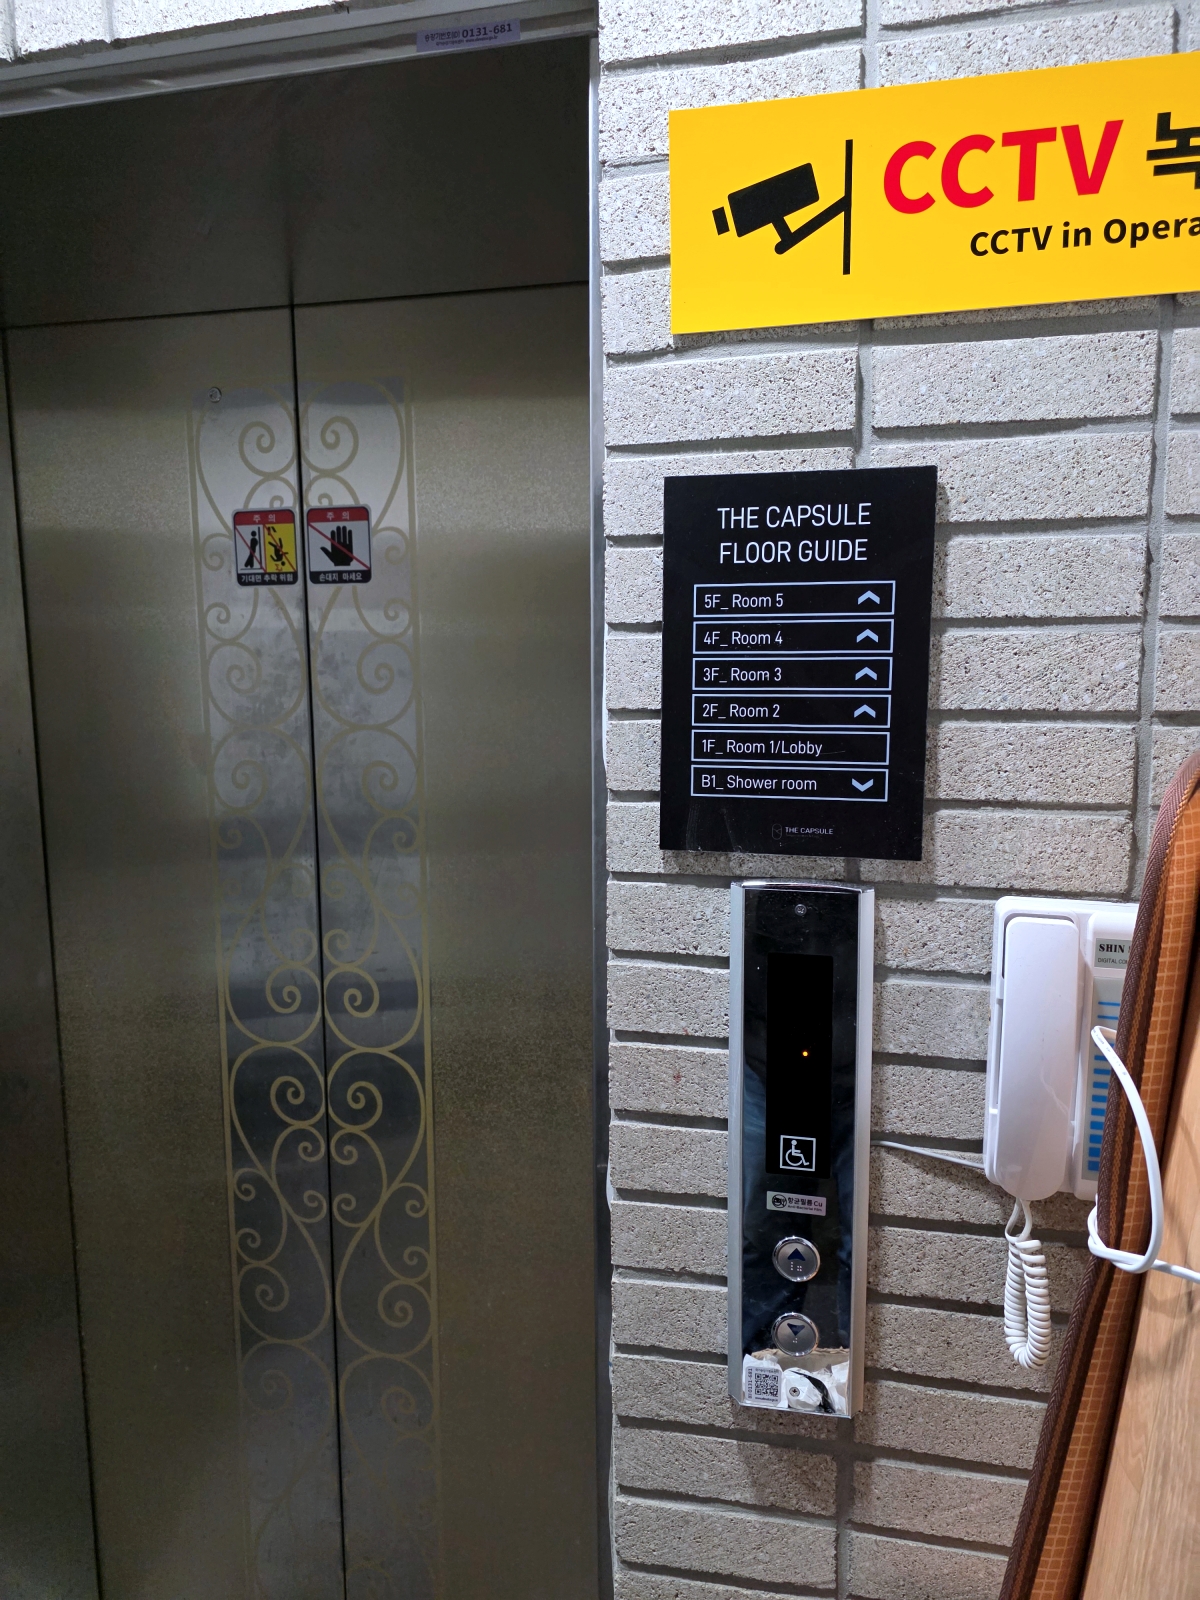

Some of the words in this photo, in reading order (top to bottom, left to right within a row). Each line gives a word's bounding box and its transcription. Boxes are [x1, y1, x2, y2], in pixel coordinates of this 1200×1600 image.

[461, 23, 513, 39] 0131-681
[883, 119, 1124, 215] CCTV
[1145, 111, 1200, 190] 녹
[969, 225, 1053, 258] CCTV
[1062, 221, 1093, 249] in
[1103, 216, 1200, 250] Opera
[717, 506, 760, 530] THE
[765, 502, 872, 528] CAPSULE
[719, 540, 792, 564] FLOOR
[798, 538, 868, 562] GUIDE
[318, 572, 339, 583] 손대지
[342, 571, 363, 581] 마세요
[704, 594, 729, 610] 5F_
[732, 593, 772, 608] Room
[775, 593, 784, 607] 5
[703, 631, 729, 647] 4F_
[731, 631, 771, 645] Room
[774, 630, 783, 645] 4
[703, 668, 727, 683] 3F_
[730, 667, 770, 681] Room
[774, 667, 782, 681] 3
[702, 703, 726, 719] 2F_
[729, 704, 769, 718] Room
[772, 704, 780, 718] 2
[701, 739, 723, 755] 1F_
[726, 739, 765, 753] Room
[769, 740, 823, 757] 1/Lobby
[701, 774, 724, 790] B1_
[726, 775, 778, 790] Shower
[781, 778, 817, 791] room
[784, 826, 799, 834] THE
[800, 827, 834, 835] CAPSULE
[1098, 943, 1126, 953] SHIN
[1097, 957, 1118, 965] DIGITAL
